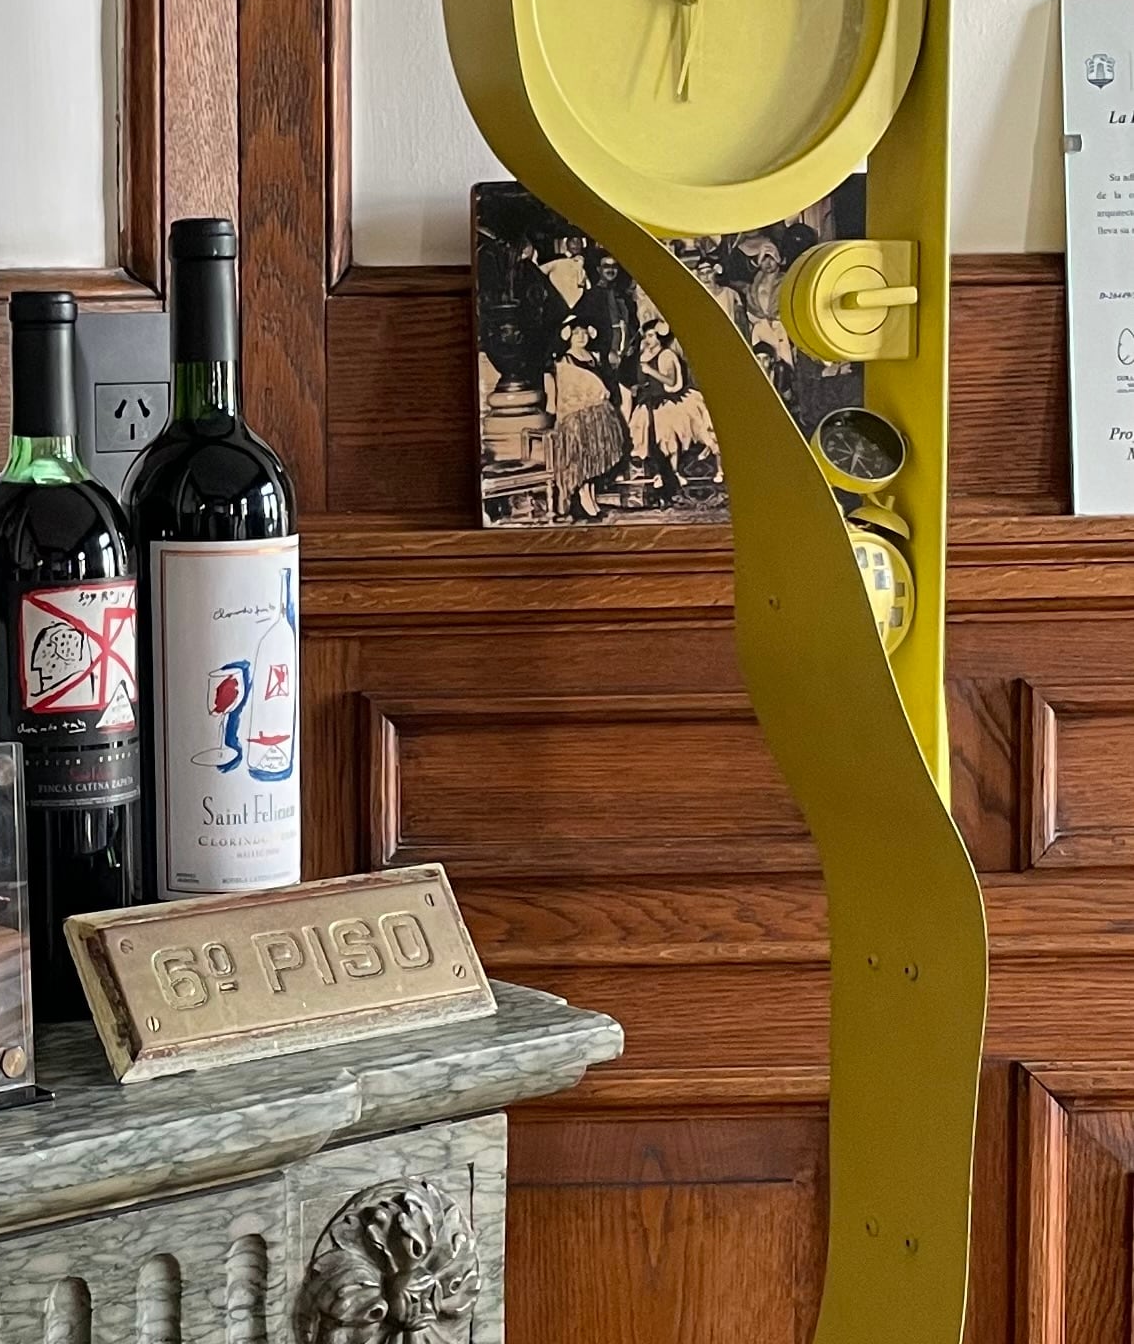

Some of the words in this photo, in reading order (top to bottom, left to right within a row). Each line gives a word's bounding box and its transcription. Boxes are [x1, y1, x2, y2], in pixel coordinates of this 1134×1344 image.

[1108, 110, 1127, 124] La
[38, 783, 72, 794] FINCAS
[75, 780, 109, 792] CATENA
[202, 795, 248, 825] Saint
[251, 909, 435, 994] PISO
